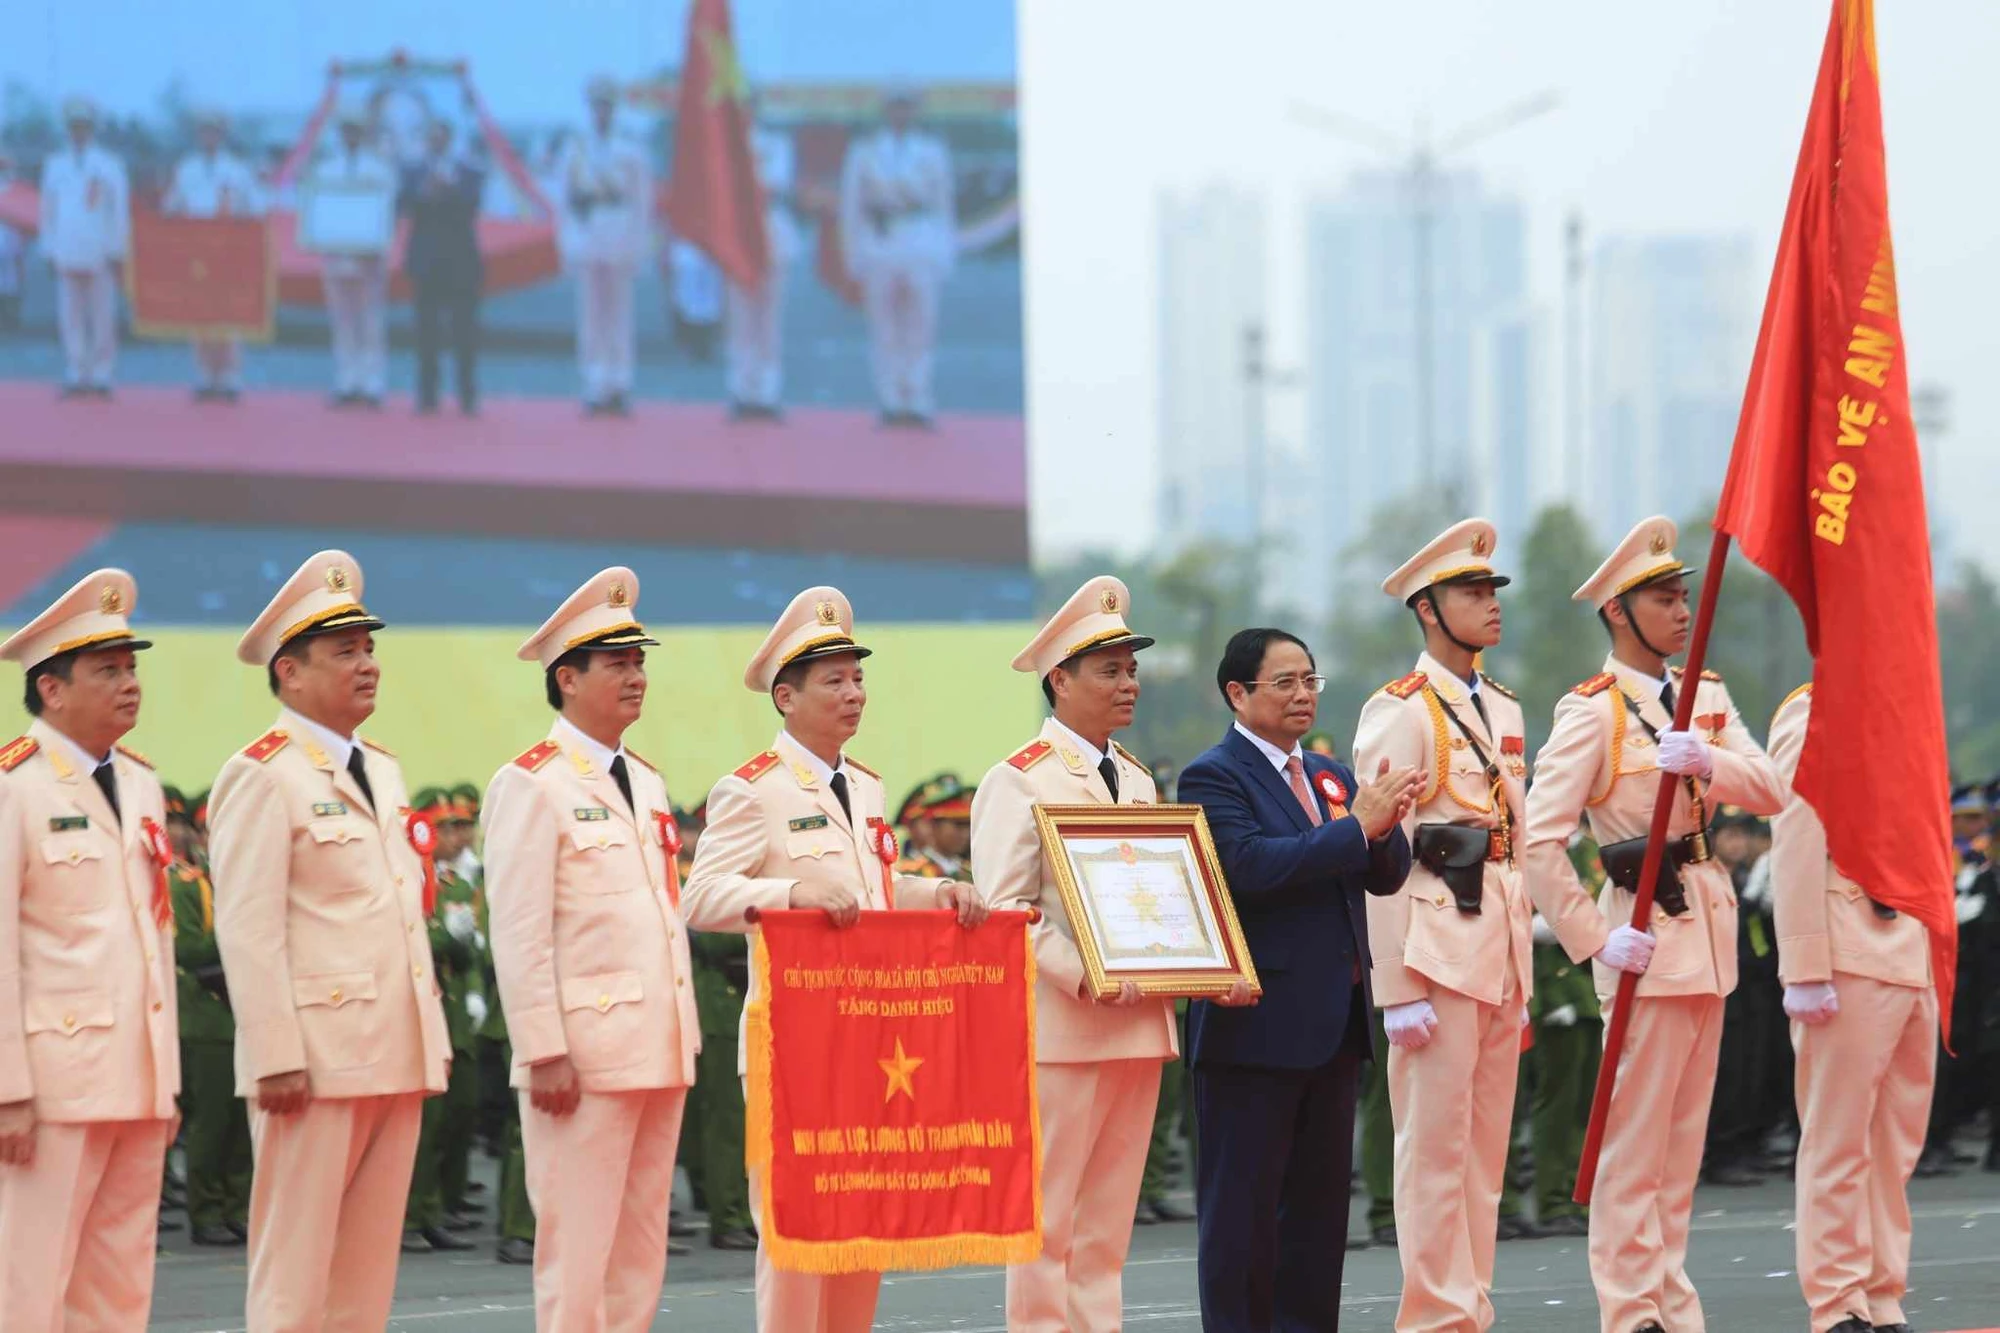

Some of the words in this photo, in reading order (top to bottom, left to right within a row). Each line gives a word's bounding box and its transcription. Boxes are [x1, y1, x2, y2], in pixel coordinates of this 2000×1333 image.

[1844, 324, 1896, 389] AN
[1837, 394, 1889, 447] VỆ
[1811, 461, 1857, 546] BẢO
[881, 1001, 919, 1016] DANH
[922, 995, 954, 1019] HIỆU
